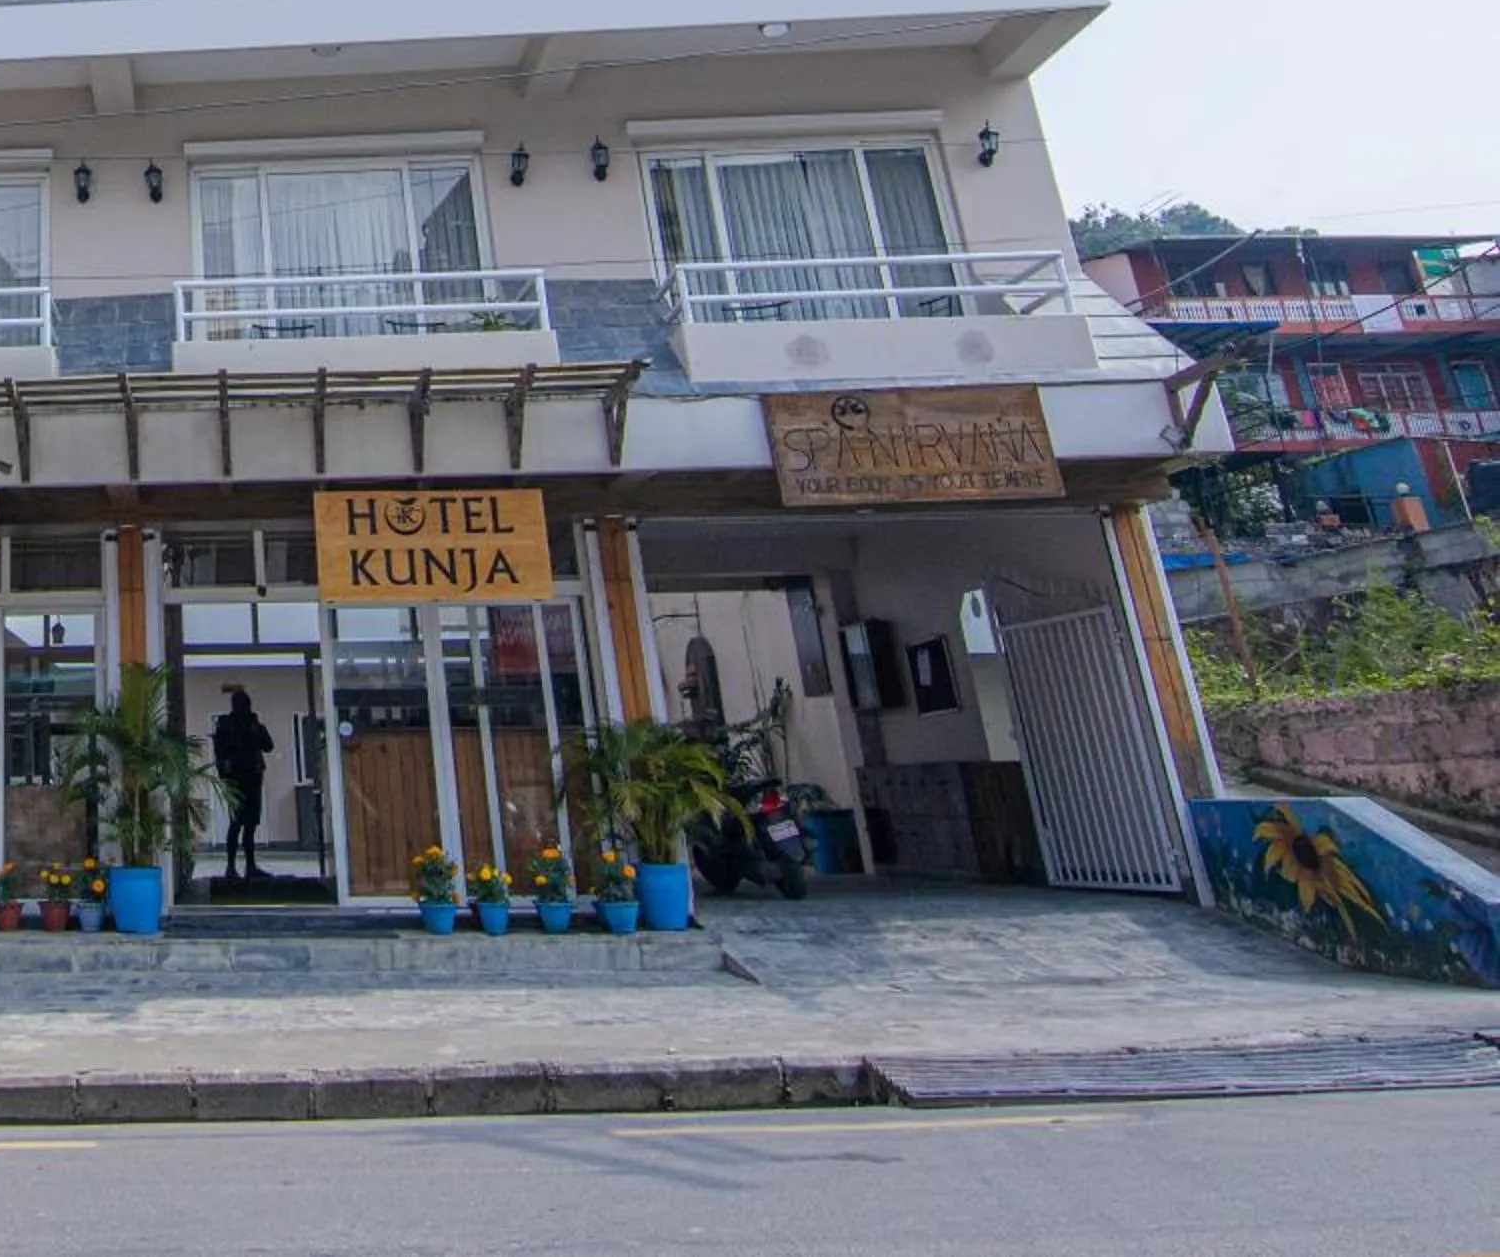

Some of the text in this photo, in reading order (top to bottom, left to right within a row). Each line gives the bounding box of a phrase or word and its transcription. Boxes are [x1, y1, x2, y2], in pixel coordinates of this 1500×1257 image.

[783, 420, 1046, 473] SPA NIRVANA
[797, 477, 840, 494] YOUR
[903, 474, 924, 490] IS
[345, 496, 515, 536] HOTEL
[350, 548, 520, 592] KUNJA
